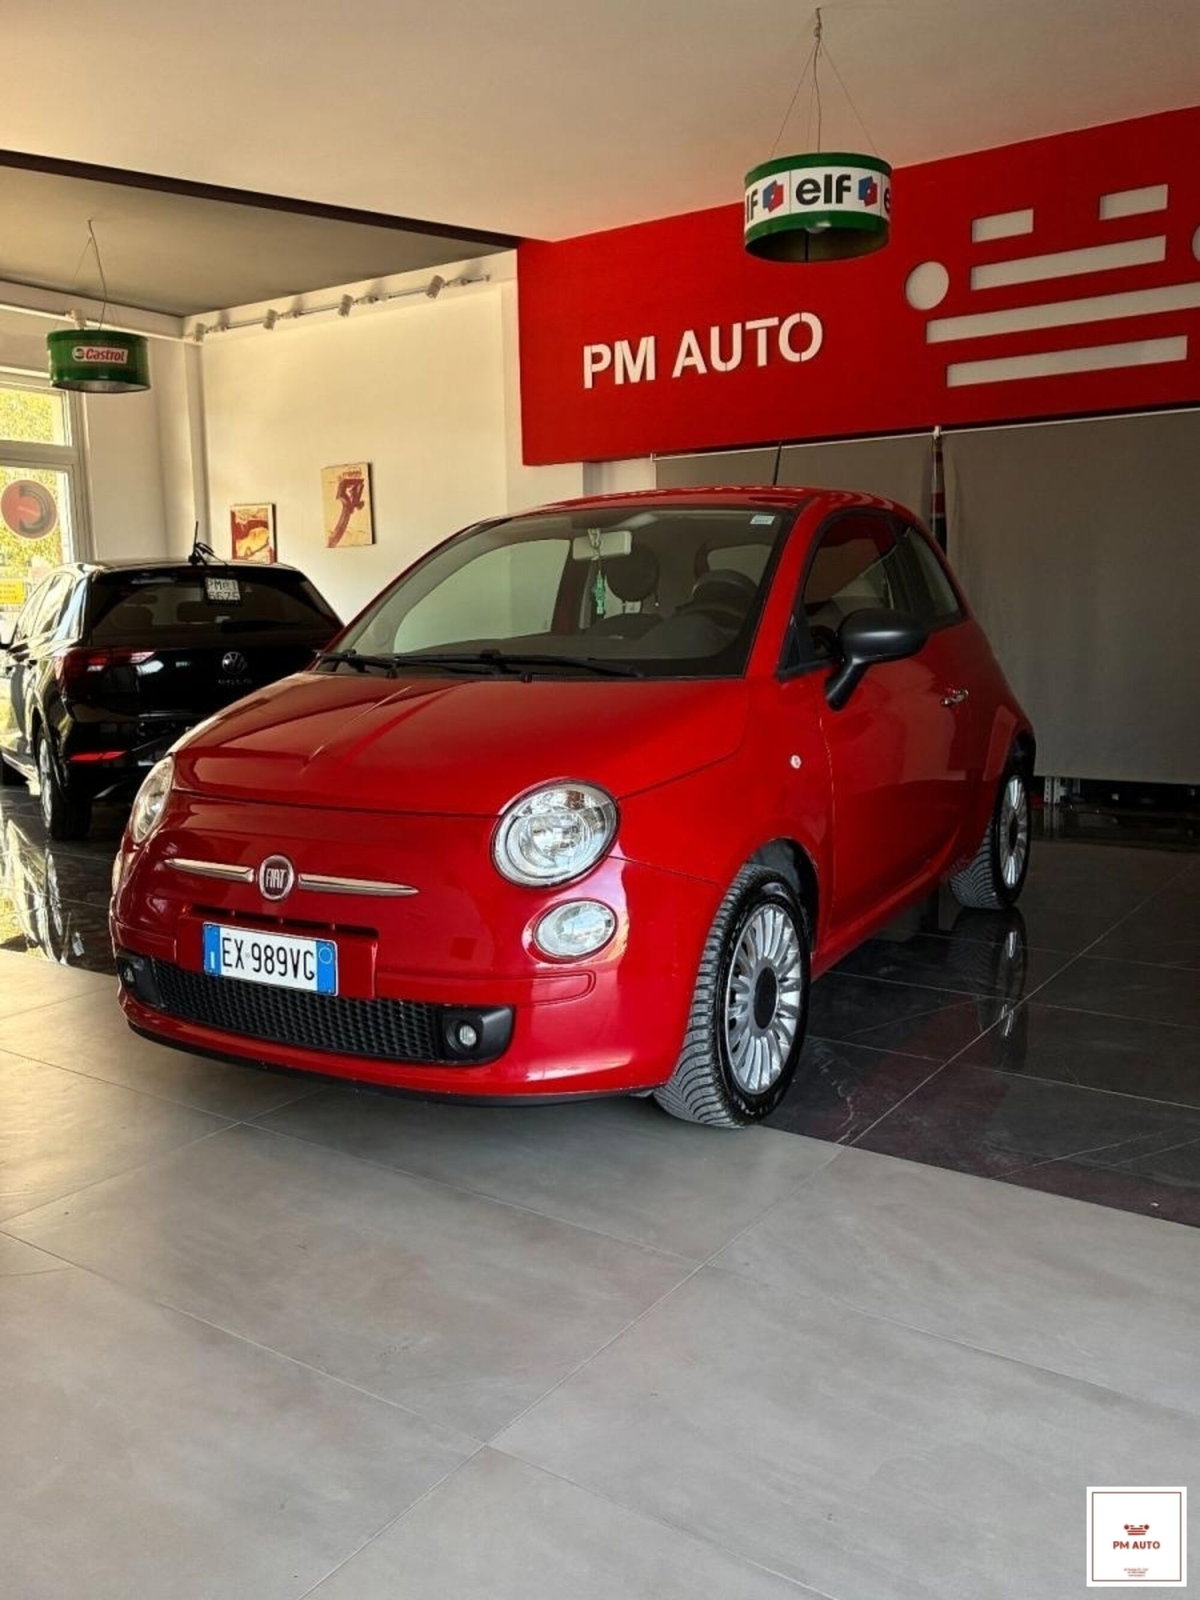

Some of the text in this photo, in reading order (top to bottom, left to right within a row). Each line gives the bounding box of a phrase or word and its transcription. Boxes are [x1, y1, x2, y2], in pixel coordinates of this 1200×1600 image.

[745, 188, 758, 223] lf
[795, 173, 852, 206] elf
[85, 347, 125, 362] Castrol
[583, 311, 823, 389] PM AUTO
[265, 867, 288, 889] FIAT
[221, 936, 316, 981] EX 989VG
